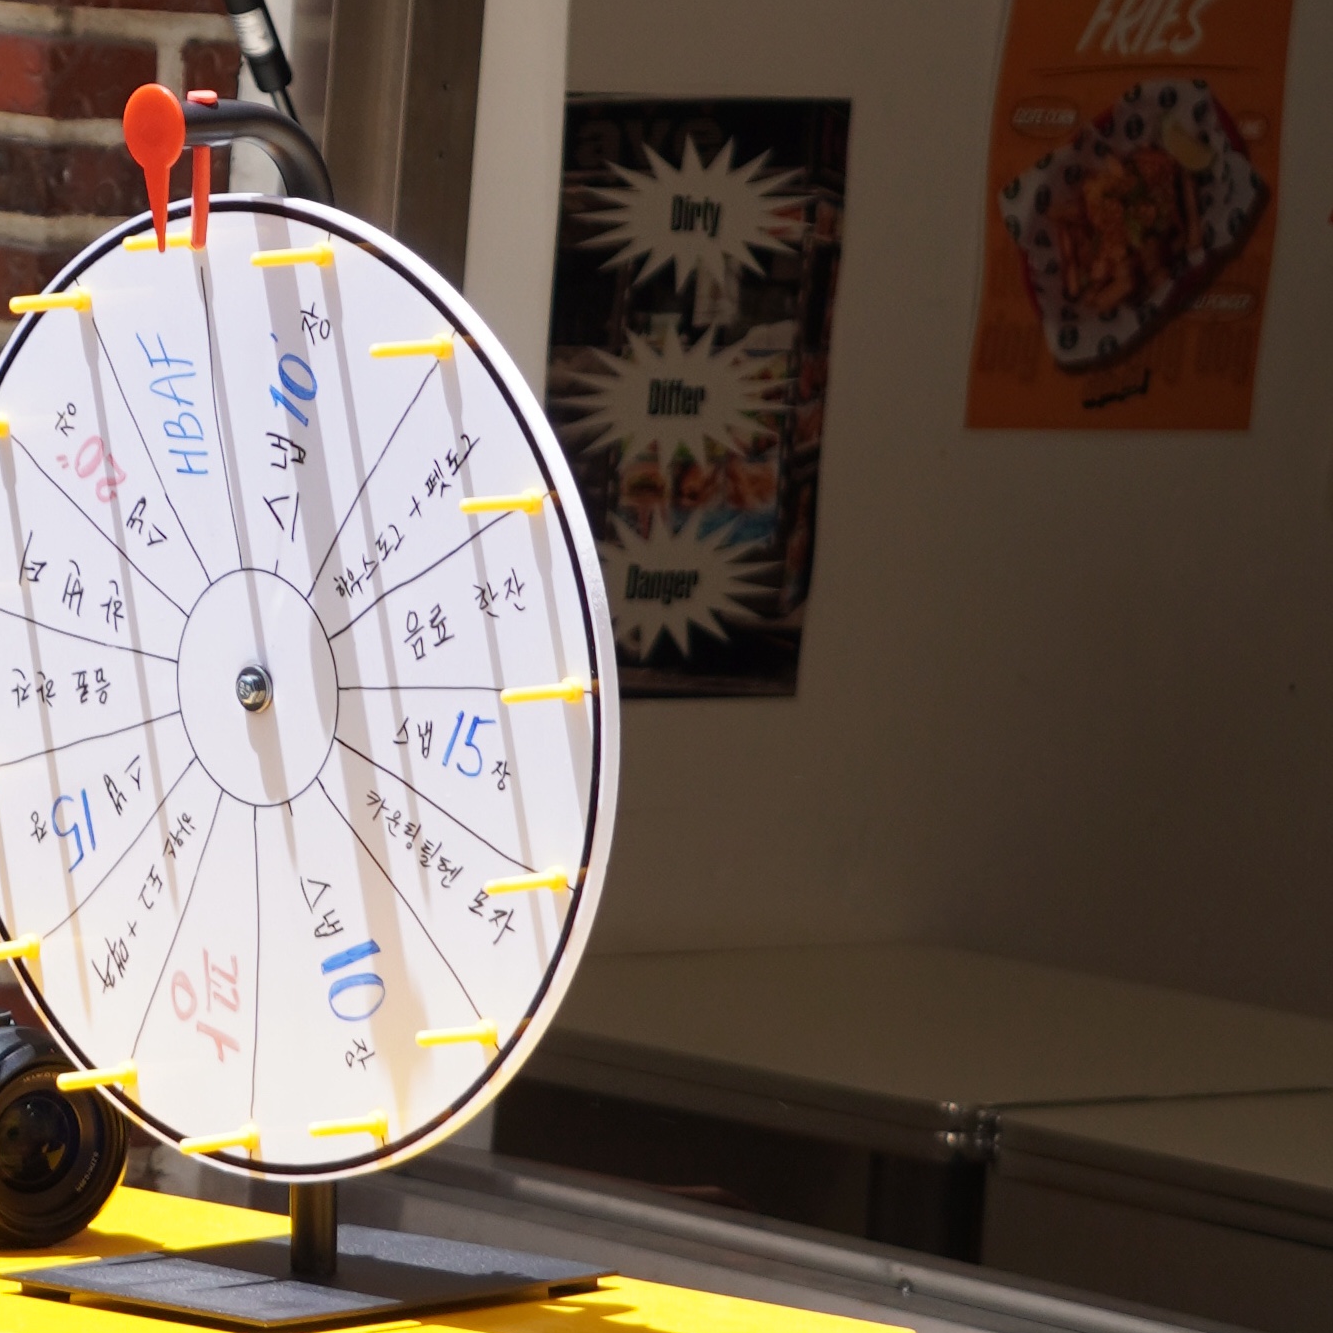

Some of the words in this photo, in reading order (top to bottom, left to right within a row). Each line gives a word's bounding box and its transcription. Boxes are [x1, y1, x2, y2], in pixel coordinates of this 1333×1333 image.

[670, 193, 722, 238] Dirty
[135, 332, 209, 475] HBAF
[647, 377, 705, 417] Differ
[625, 563, 700, 605] Danger
[404, 602, 456, 661] 음료
[72, 668, 112, 706] 음료
[392, 717, 434, 759] 스냅
[467, 887, 517, 946] 모자
[90, 936, 131, 995] 맥주
[170, 946, 242, 1064] 꽝
